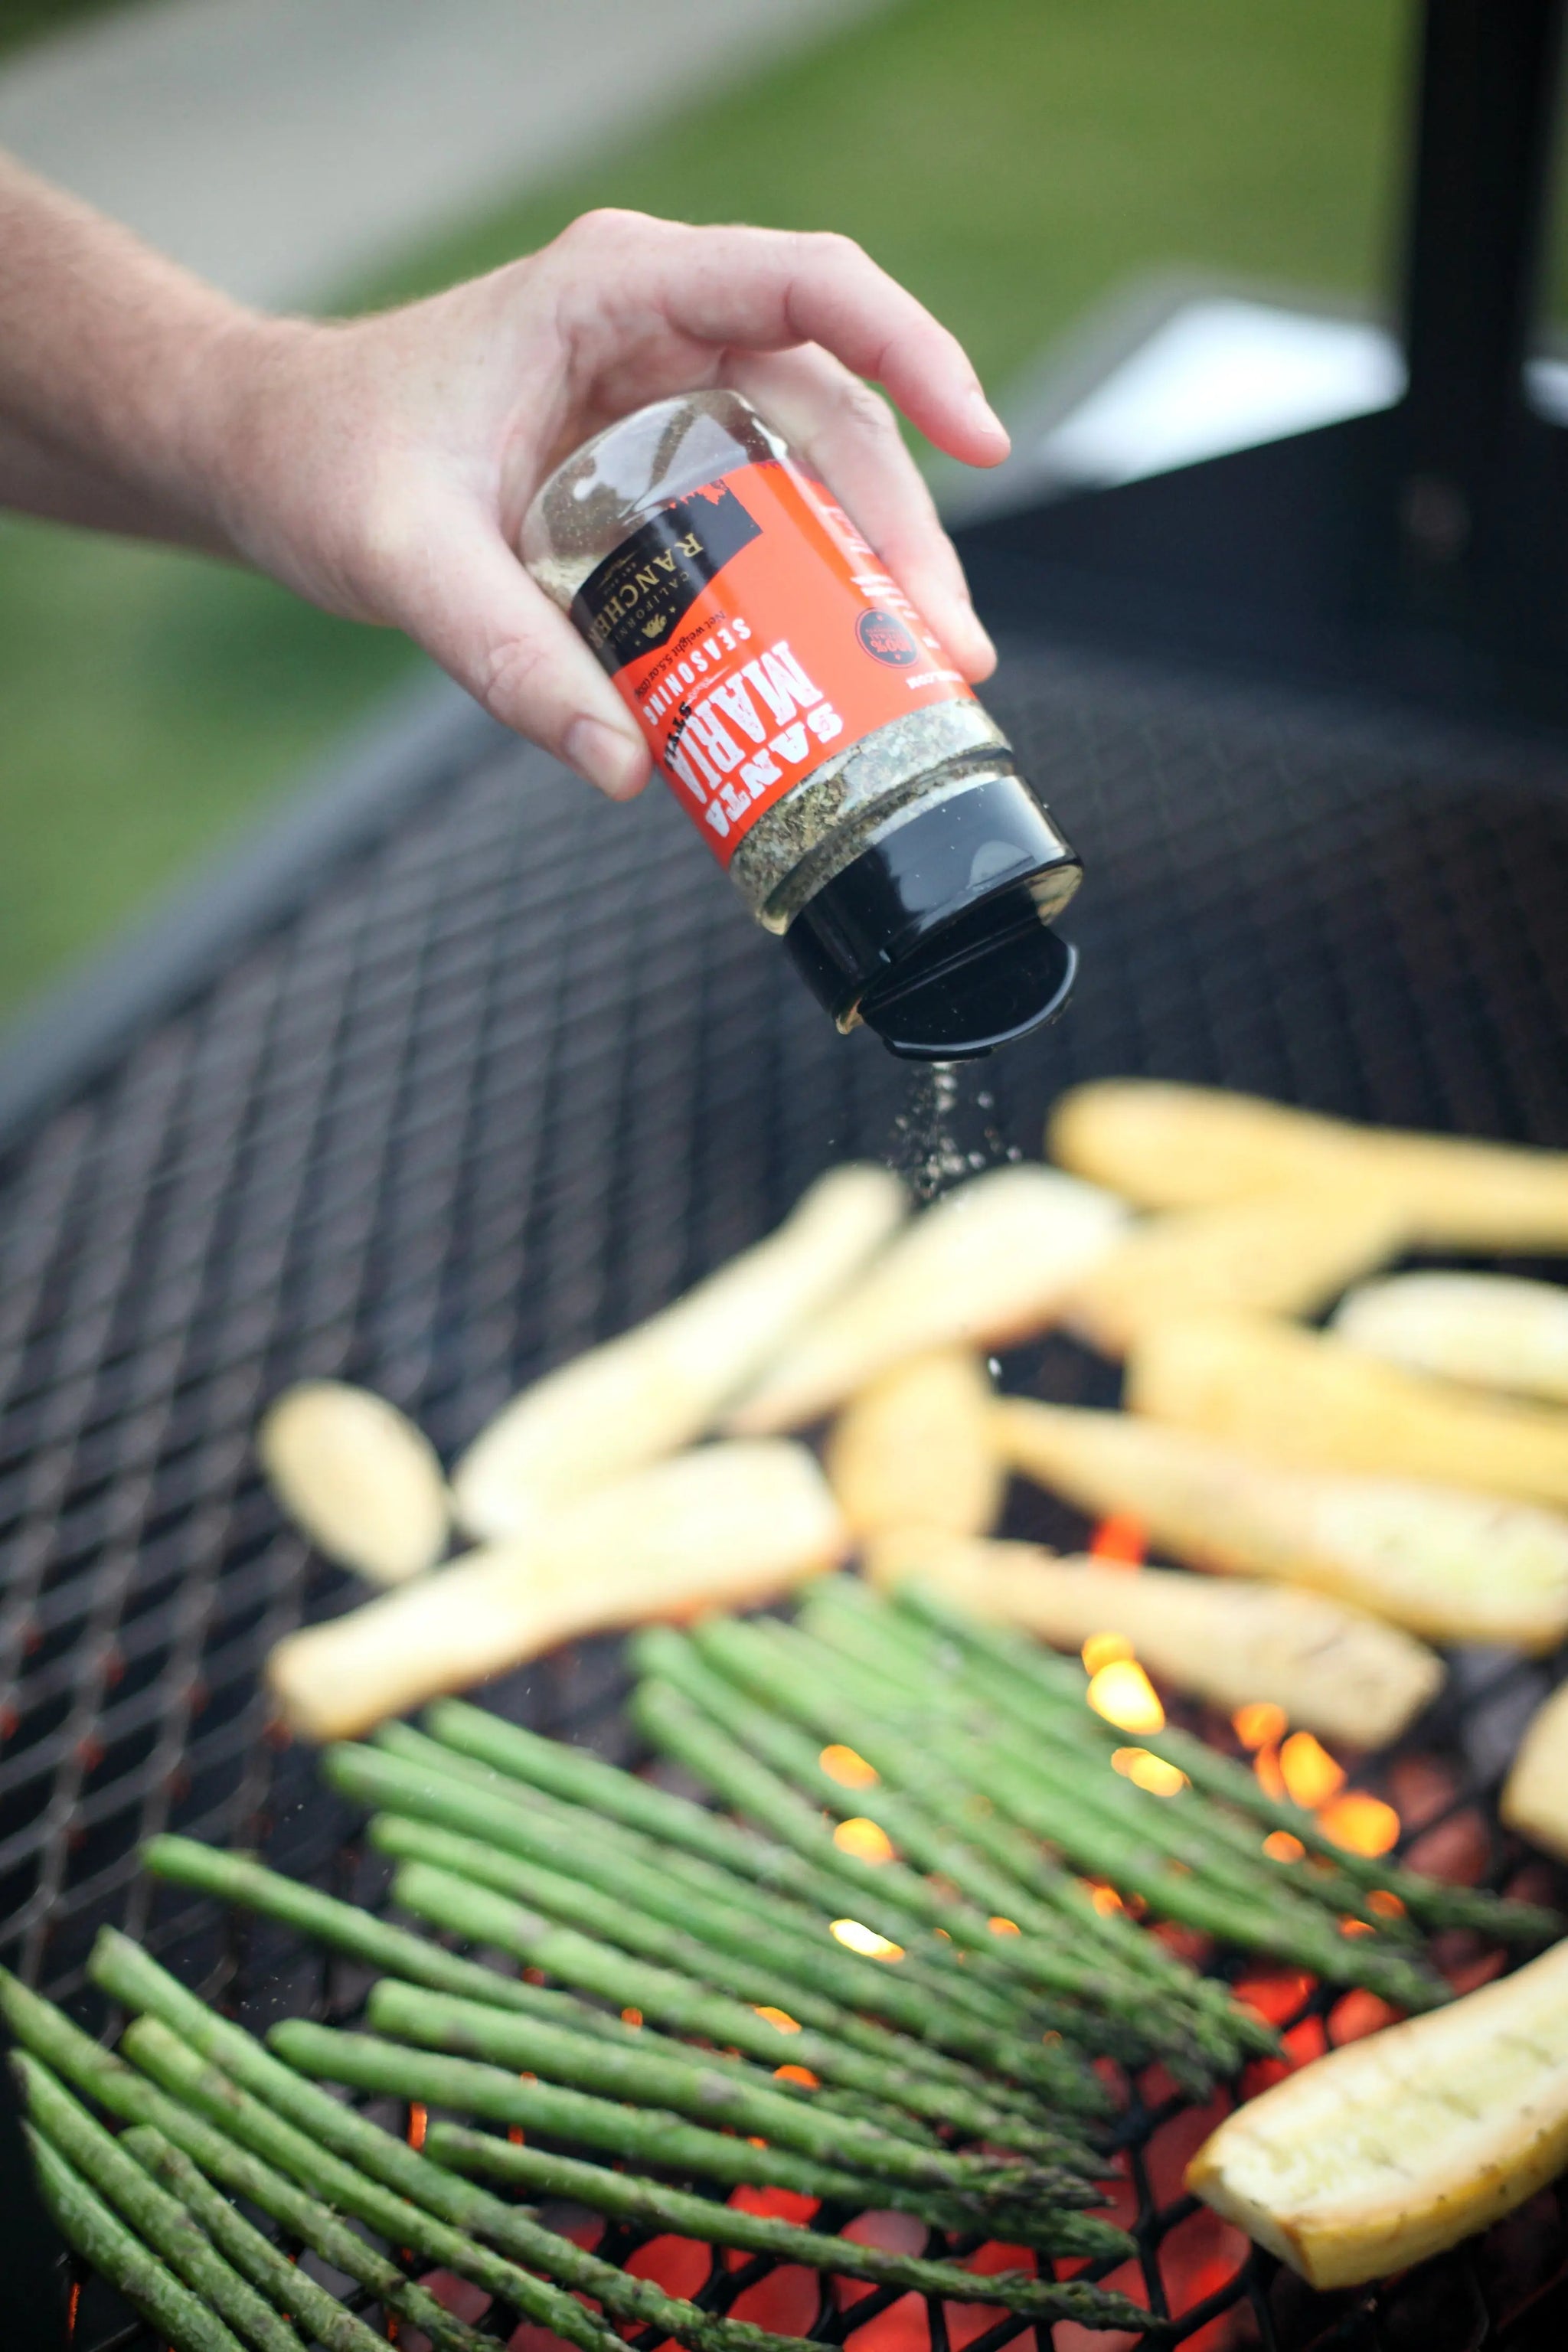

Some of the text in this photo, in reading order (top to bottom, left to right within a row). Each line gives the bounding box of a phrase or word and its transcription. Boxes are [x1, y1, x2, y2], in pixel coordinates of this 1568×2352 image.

[587, 533, 704, 649] RANCHER
[671, 626, 705, 657] weight
[706, 610, 726, 626] Net
[643, 618, 751, 726] SEASONING
[668, 640, 824, 804] MARIA
[704, 702, 844, 838] SANTA
